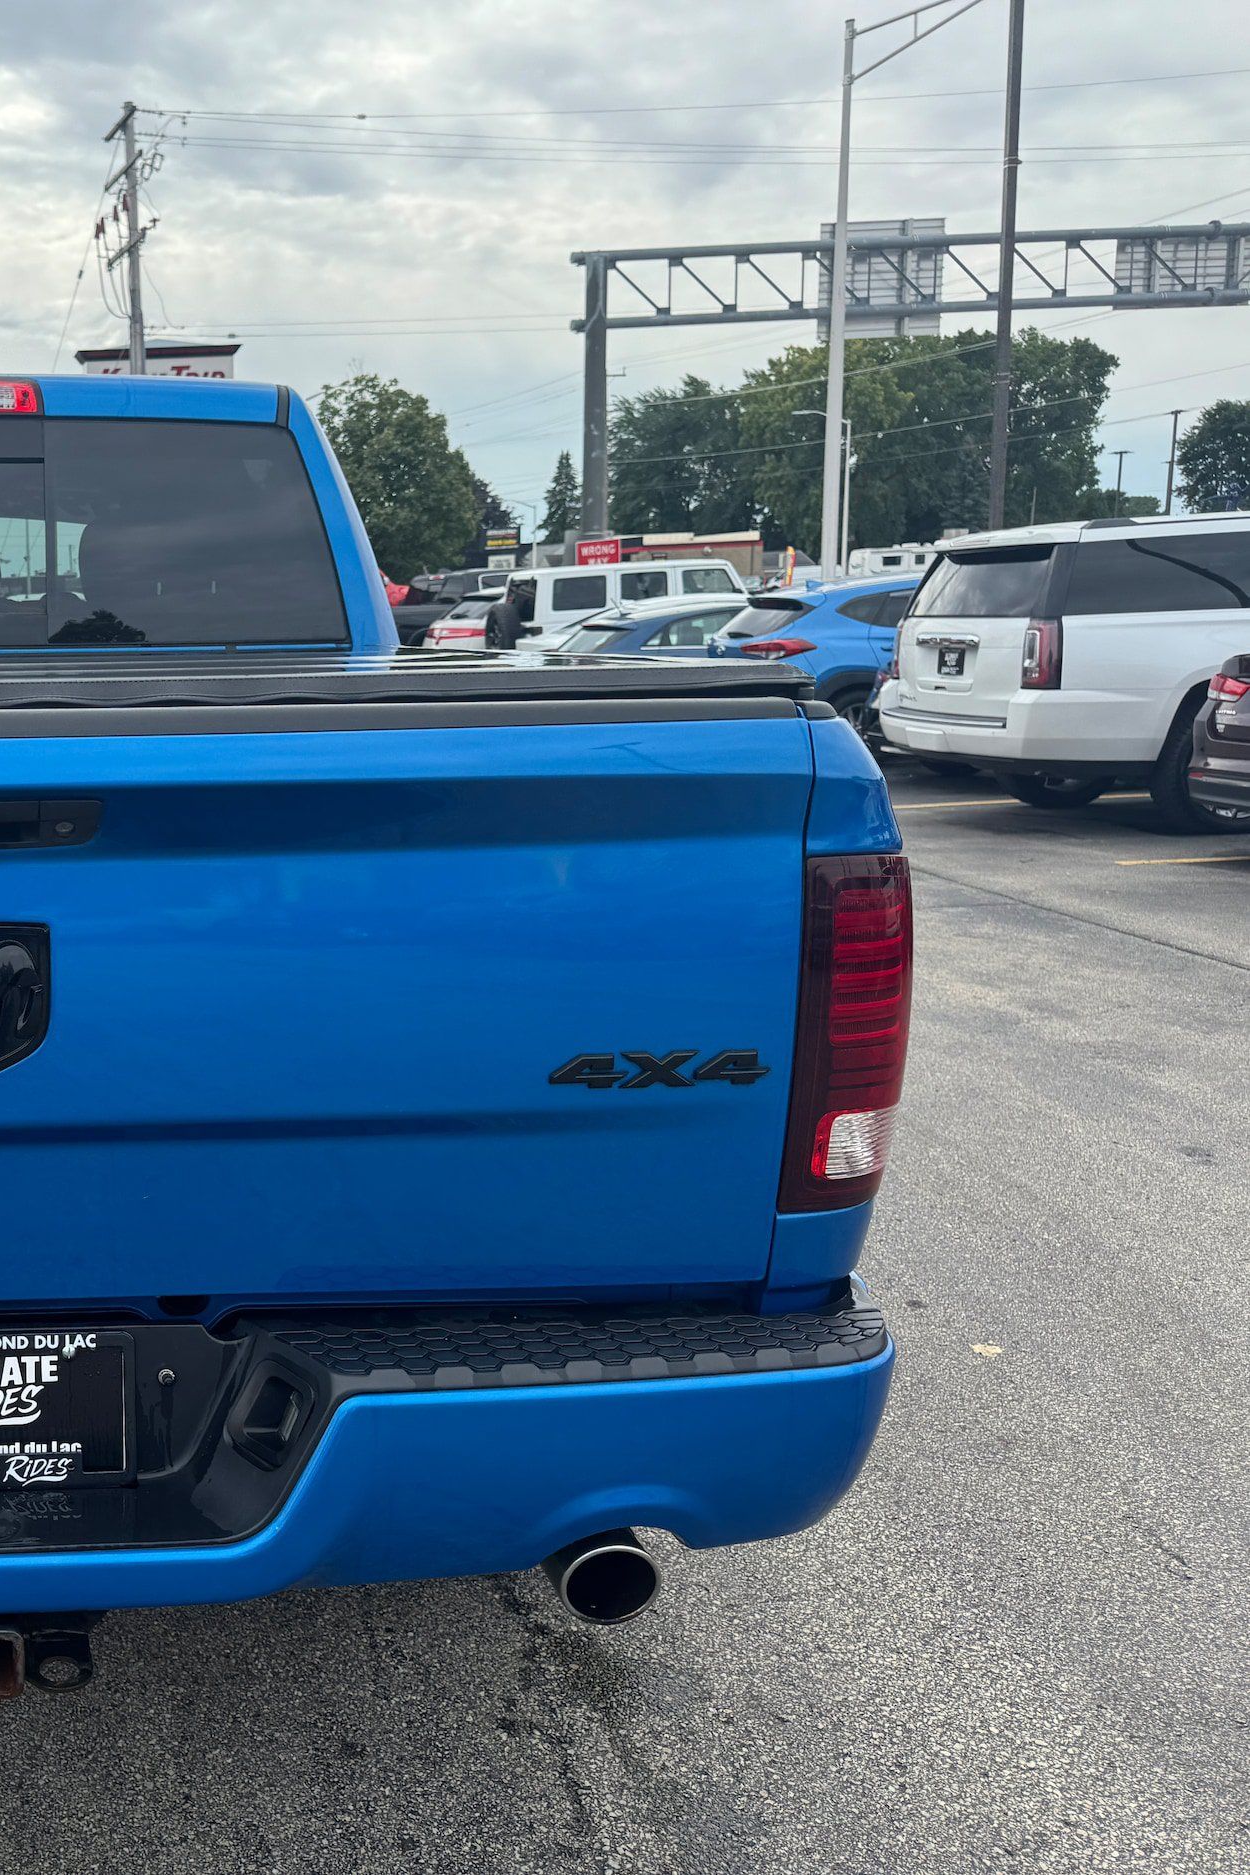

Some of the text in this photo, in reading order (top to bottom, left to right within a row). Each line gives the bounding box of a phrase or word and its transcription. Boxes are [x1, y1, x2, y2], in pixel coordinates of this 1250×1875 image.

[580, 544, 616, 557] WRONG
[34, 1335, 59, 1350] DU
[64, 1333, 97, 1350] LAC
